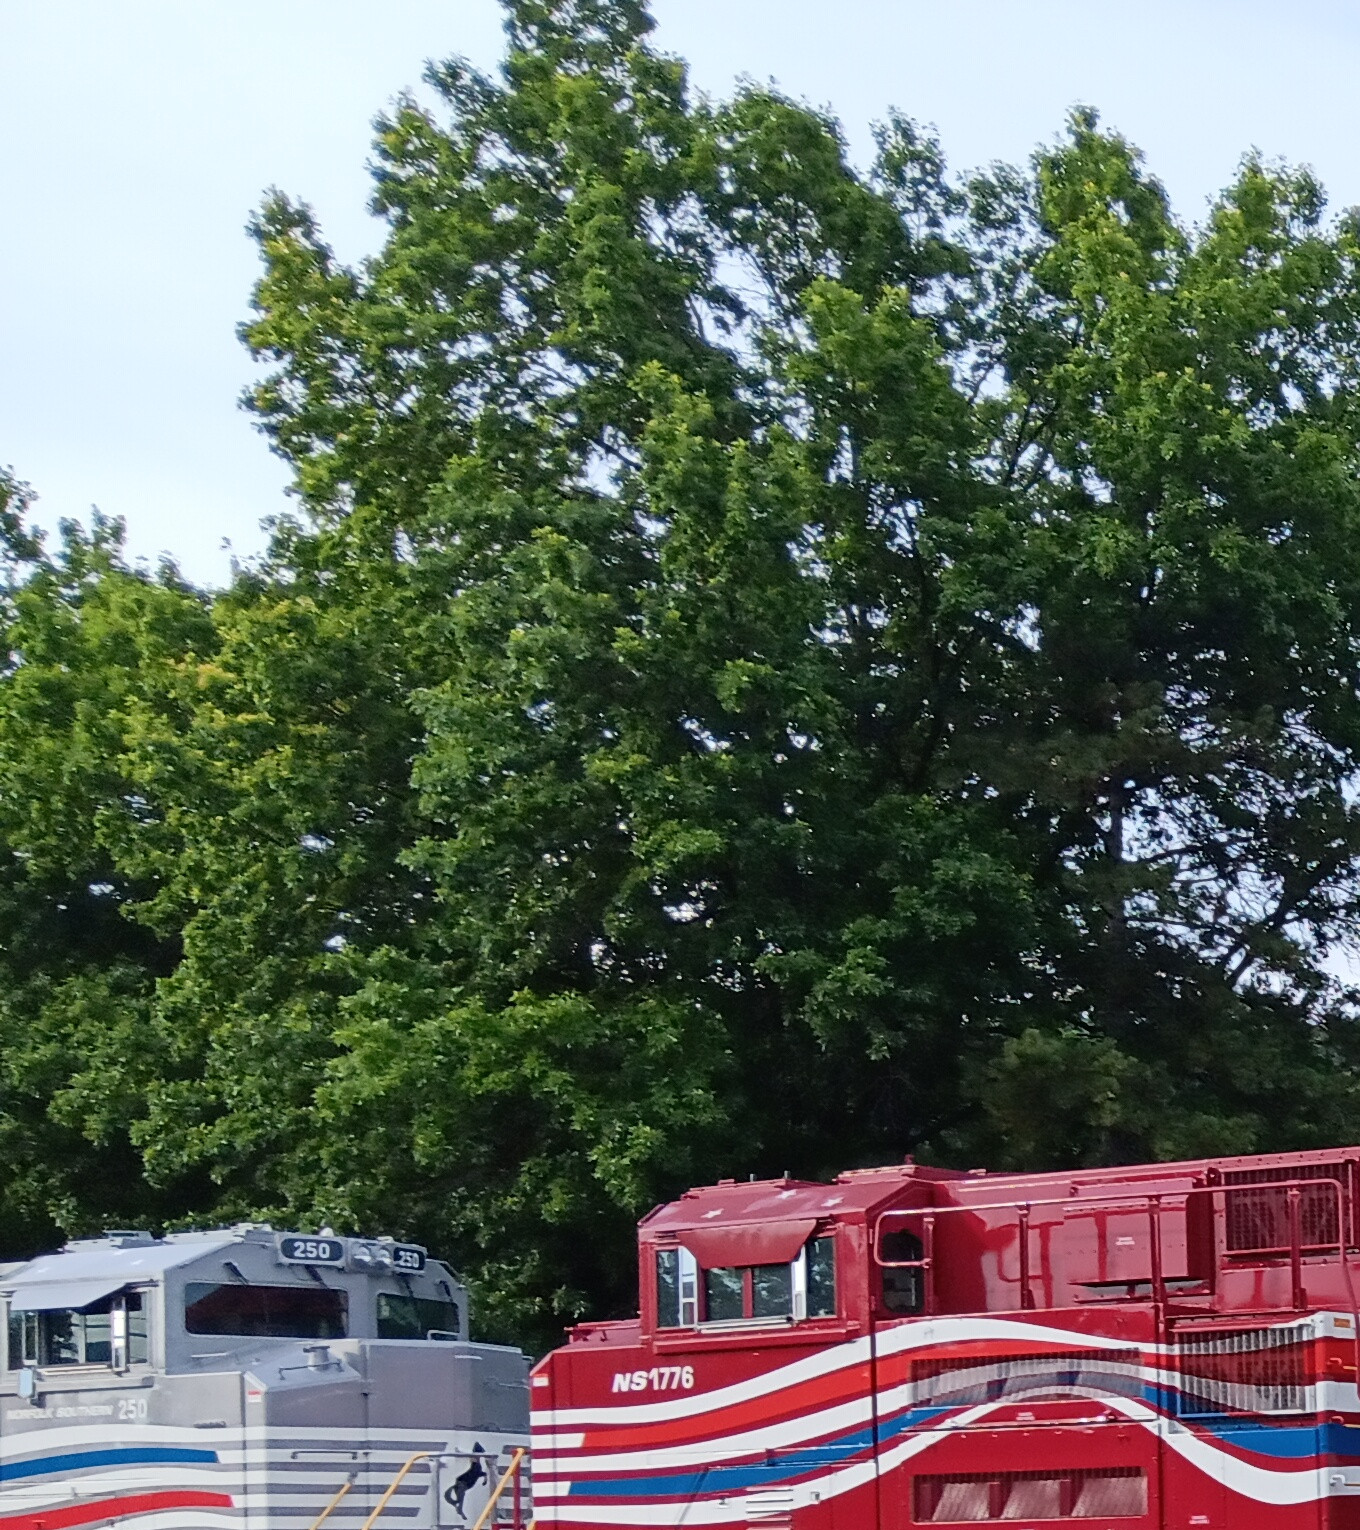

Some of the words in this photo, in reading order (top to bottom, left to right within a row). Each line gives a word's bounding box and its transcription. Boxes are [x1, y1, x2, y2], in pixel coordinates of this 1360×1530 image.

[293, 1241, 331, 1259] 250
[398, 1250, 420, 1268] 250
[118, 1399, 148, 1420] 250
